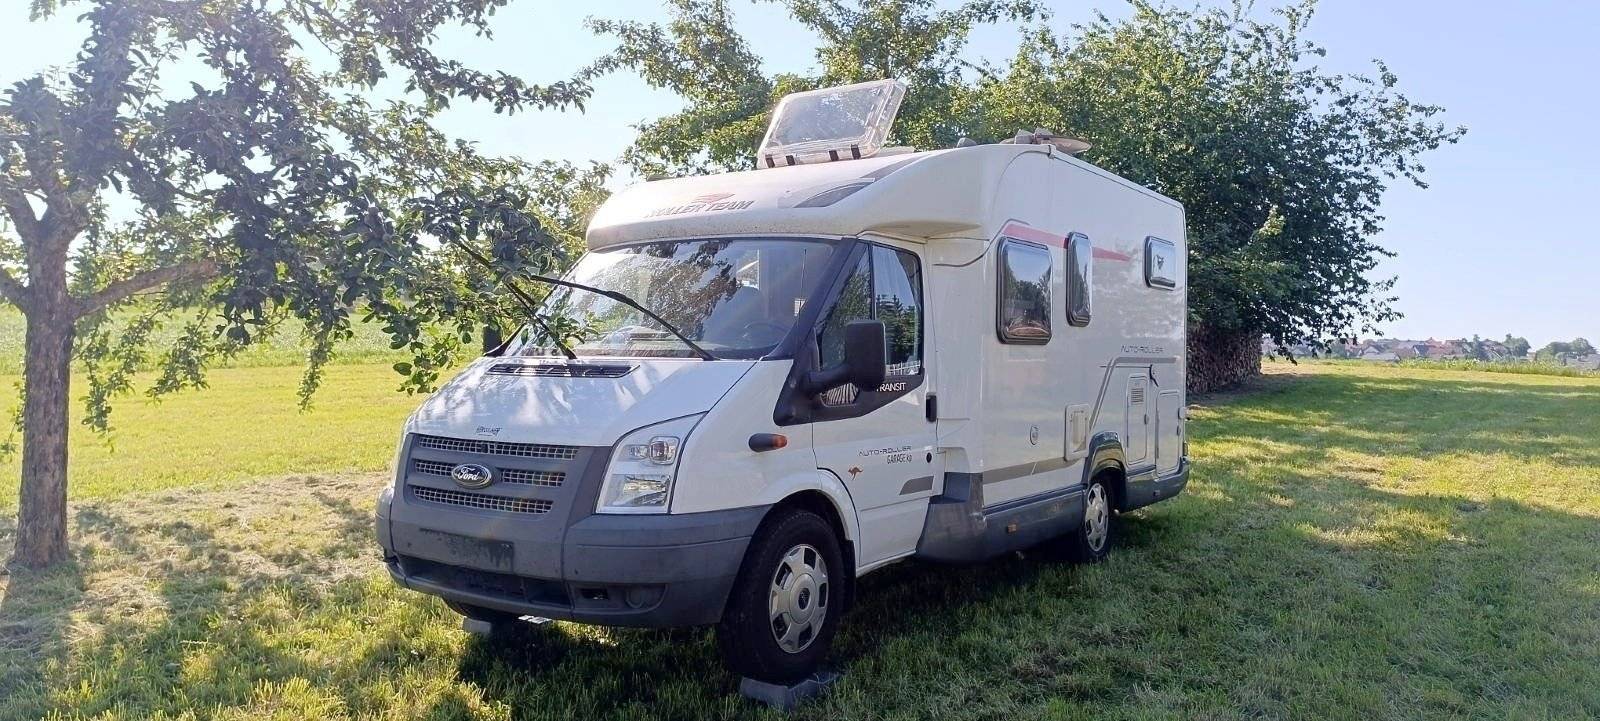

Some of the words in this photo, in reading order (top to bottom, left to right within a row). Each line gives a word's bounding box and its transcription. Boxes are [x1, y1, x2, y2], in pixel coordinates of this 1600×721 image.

[705, 200, 755, 212] TEAM
[877, 382, 906, 392] RANSIT
[458, 467, 480, 480] Ford
